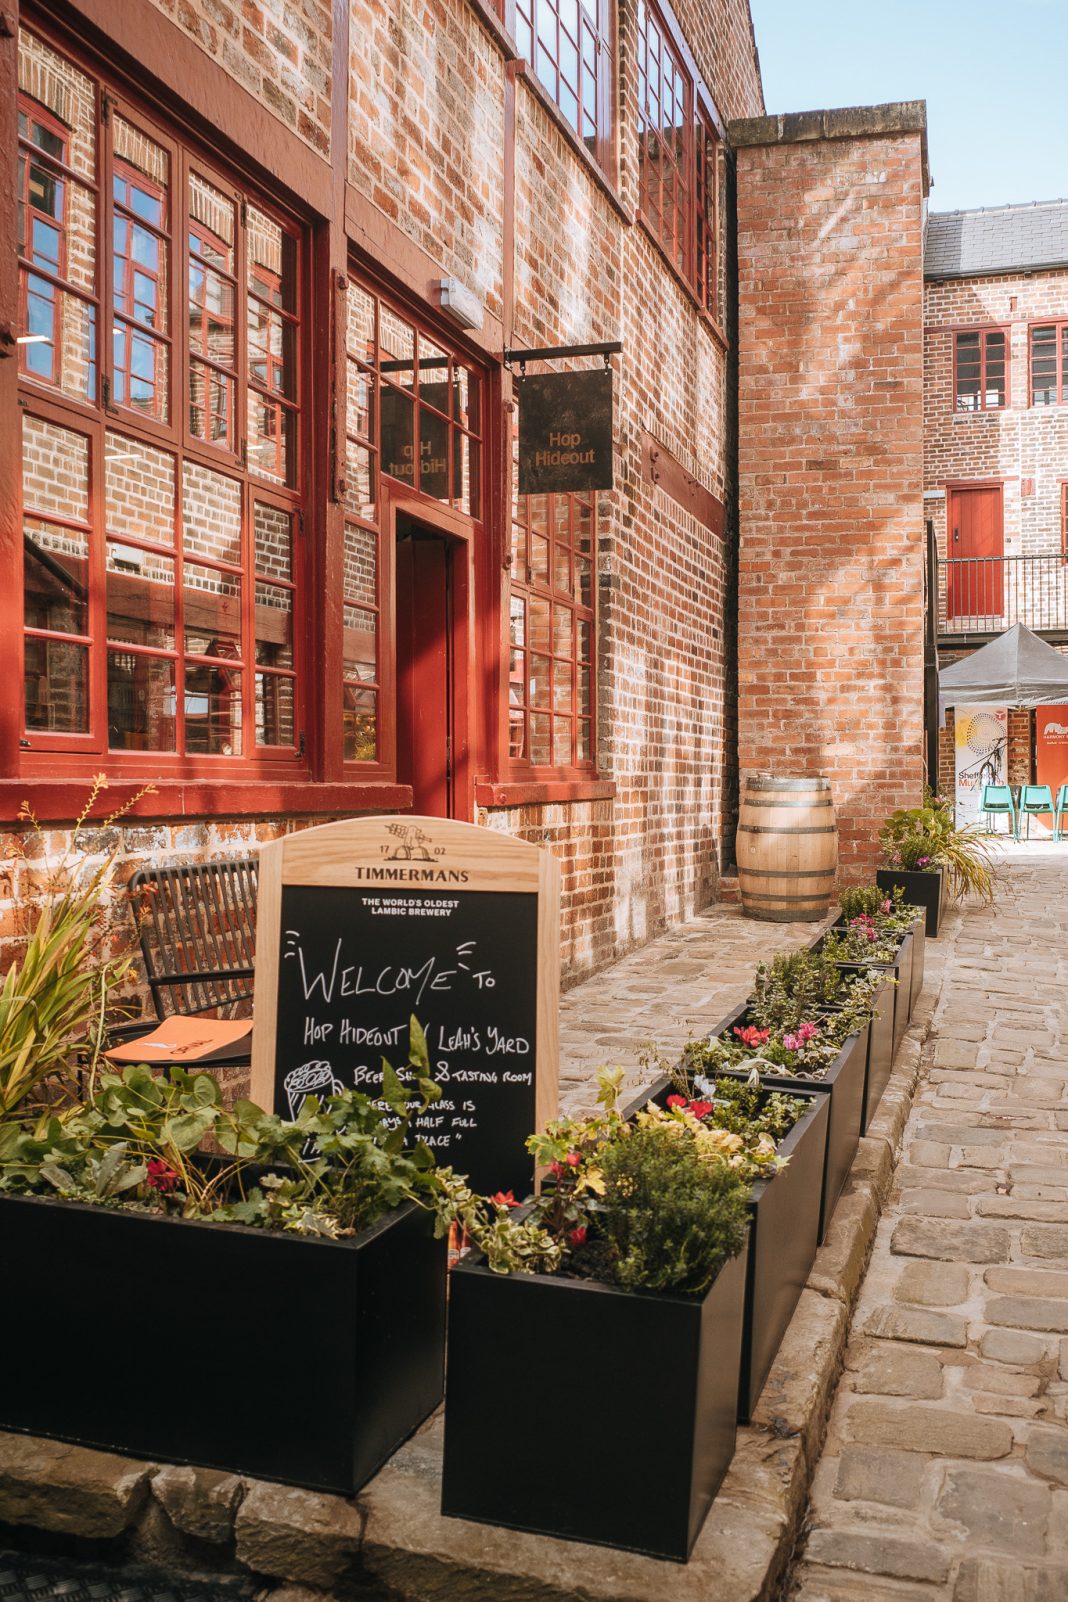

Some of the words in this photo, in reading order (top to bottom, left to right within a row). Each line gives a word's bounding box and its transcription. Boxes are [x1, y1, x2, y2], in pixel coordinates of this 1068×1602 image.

[549, 432, 581, 448] Hop
[535, 448, 596, 466] Hideout
[380, 845, 390, 854] 17
[434, 847, 446, 855] 02
[355, 866, 469, 883] TIMMERMANS
[362, 898, 381, 906] THE
[382, 898, 422, 907] WORLD'S
[424, 899, 460, 908] OLDEST
[371, 907, 407, 915] LAMBIC
[408, 908, 452, 917] BREWERY
[303, 1016, 334, 1046] HOP
[340, 1018, 408, 1046] HIDEOUT
[438, 1025, 481, 1052] LEAH'S
[485, 1026, 530, 1055] YARD
[452, 1070, 498, 1084] TASTING
[503, 1071, 532, 1086] ROOM
[462, 1100, 476, 1111] IS
[415, 1116, 445, 1129] HALF
[451, 1117, 478, 1128] FULL
